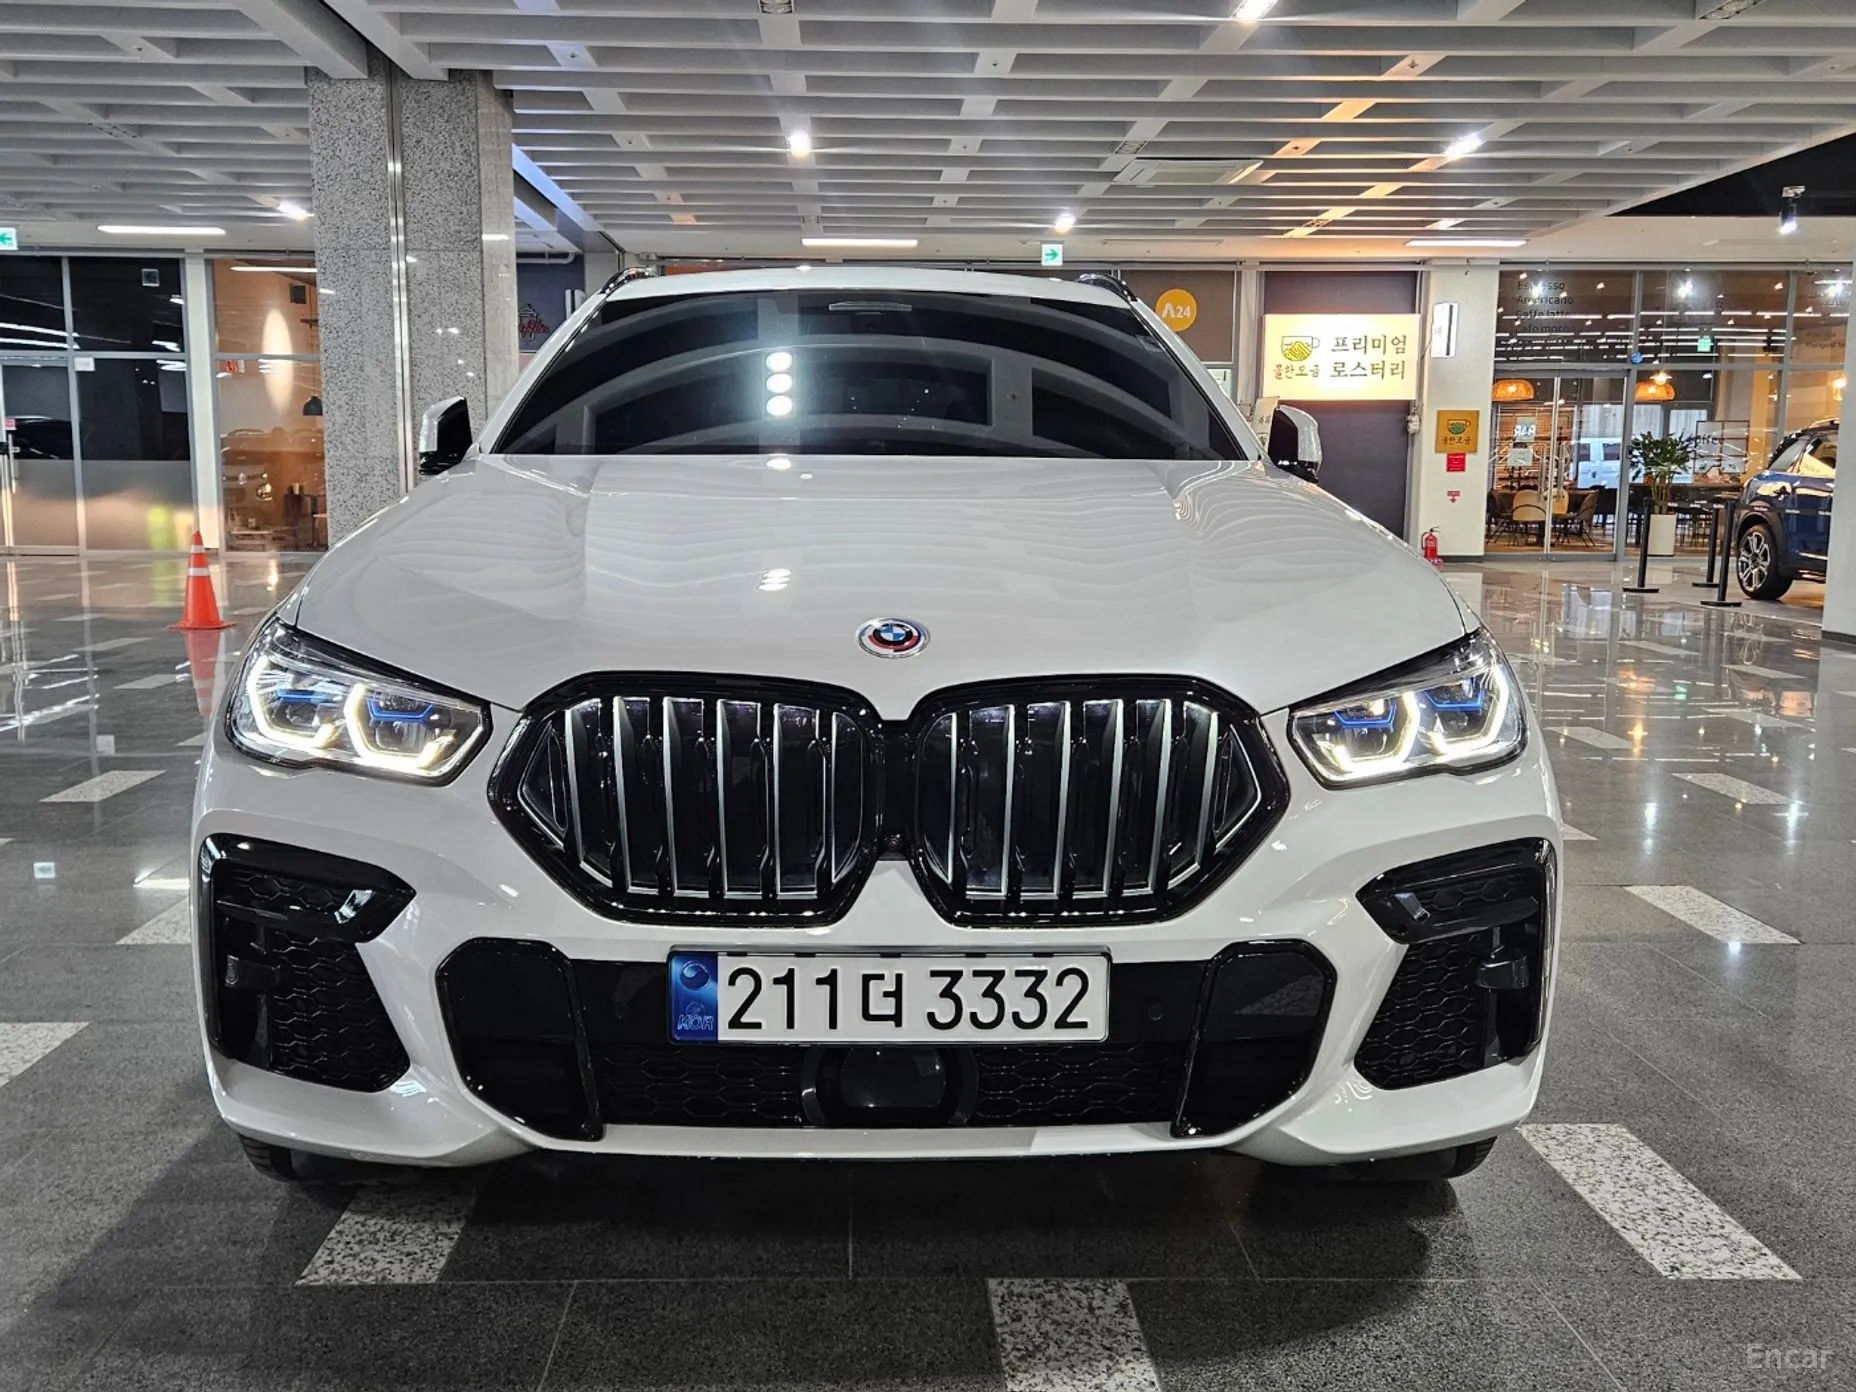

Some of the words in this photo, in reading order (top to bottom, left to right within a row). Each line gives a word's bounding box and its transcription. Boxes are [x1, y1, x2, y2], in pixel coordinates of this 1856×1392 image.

[1518, 281, 1565, 293] Espesso
[1162, 302, 1191, 318] A24
[1331, 334, 1407, 355] 프리미엄
[1330, 360, 1406, 380] 로스터리
[726, 966, 903, 1031] 211더
[926, 966, 1089, 1030] 3332
[677, 1014, 714, 1031] KOR
